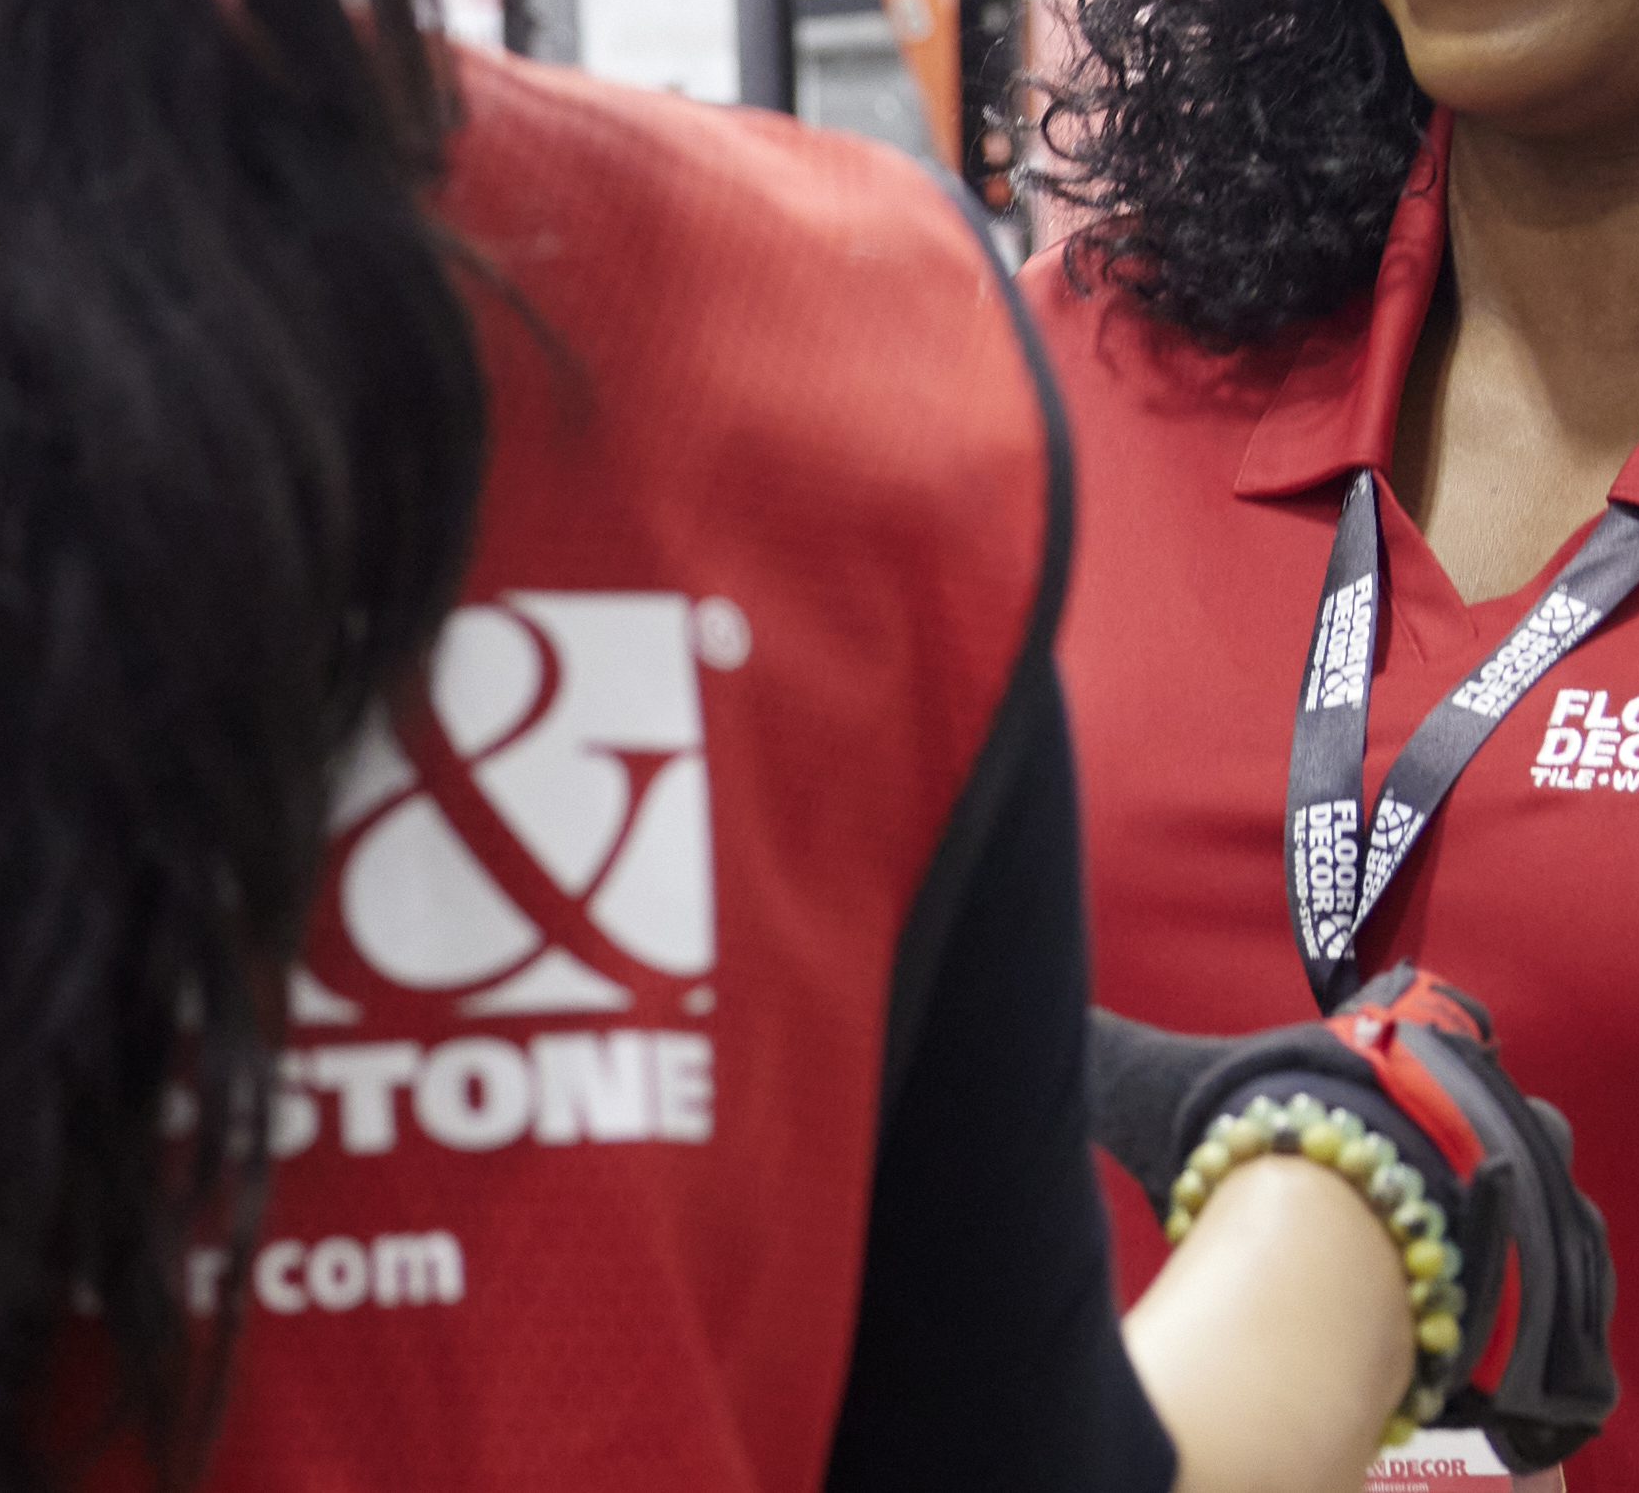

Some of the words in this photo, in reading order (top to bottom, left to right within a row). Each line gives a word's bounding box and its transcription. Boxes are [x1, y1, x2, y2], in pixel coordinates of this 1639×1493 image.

[1325, 582, 1355, 678] DECOR
[1347, 572, 1373, 664] FLOOR
[1451, 628, 1539, 710] FLOOR
[1470, 634, 1558, 716] DECOR
[1529, 765, 1596, 791] TILE
[1308, 801, 1336, 914] DECOR
[1333, 798, 1359, 912] FLOOR
